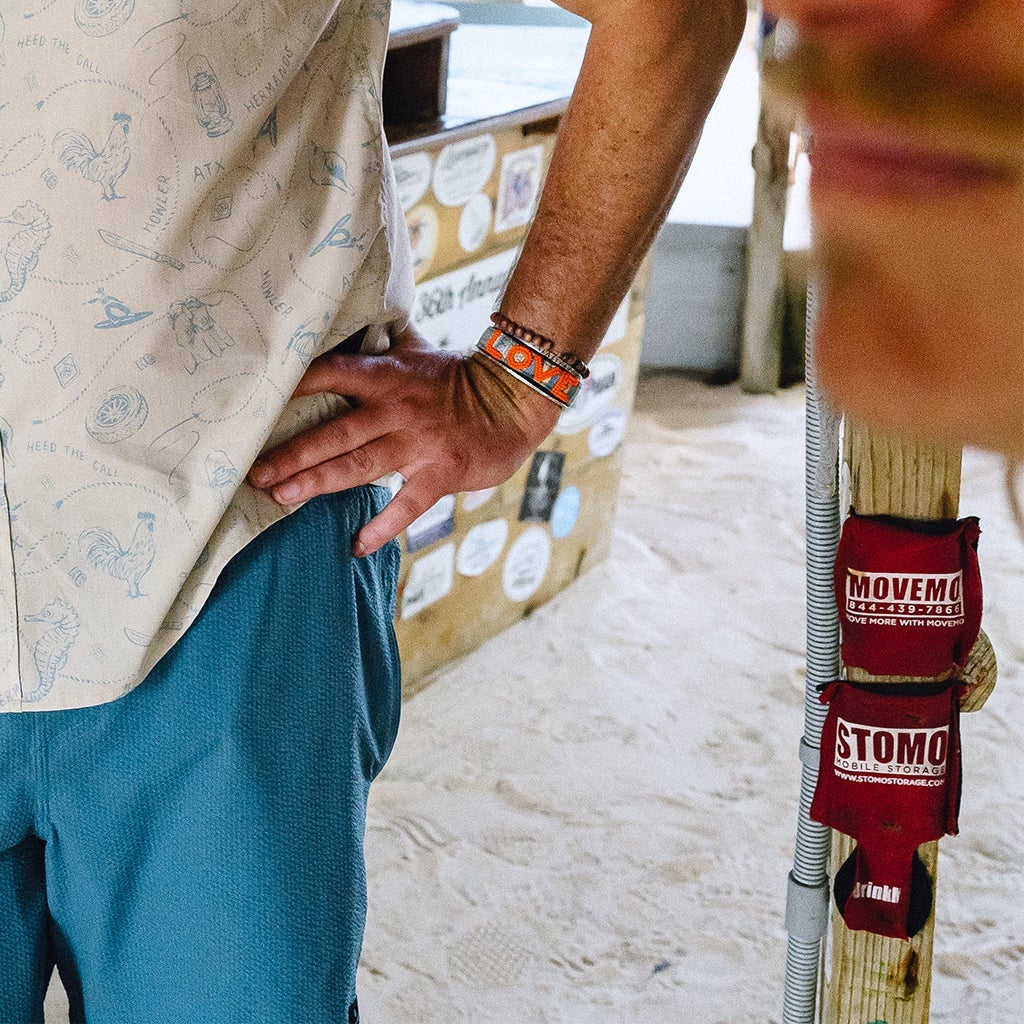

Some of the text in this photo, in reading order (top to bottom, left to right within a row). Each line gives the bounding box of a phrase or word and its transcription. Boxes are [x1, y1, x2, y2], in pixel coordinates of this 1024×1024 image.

[17, 35, 102, 74] HEED THE CALL
[193, 160, 226, 183] ATX
[143, 174, 171, 234] HOWLER
[260, 269, 294, 317] HOWLER
[484, 329, 580, 404] LOVE
[27, 440, 119, 478] HEED THE CALL
[849, 575, 961, 603] MOVEMO
[869, 617, 897, 626] MORE
[900, 618, 924, 627] WITH
[926, 618, 965, 627] MOVEMO
[837, 721, 948, 766] STOMO
[835, 758, 947, 775] MOBILE STORAGE
